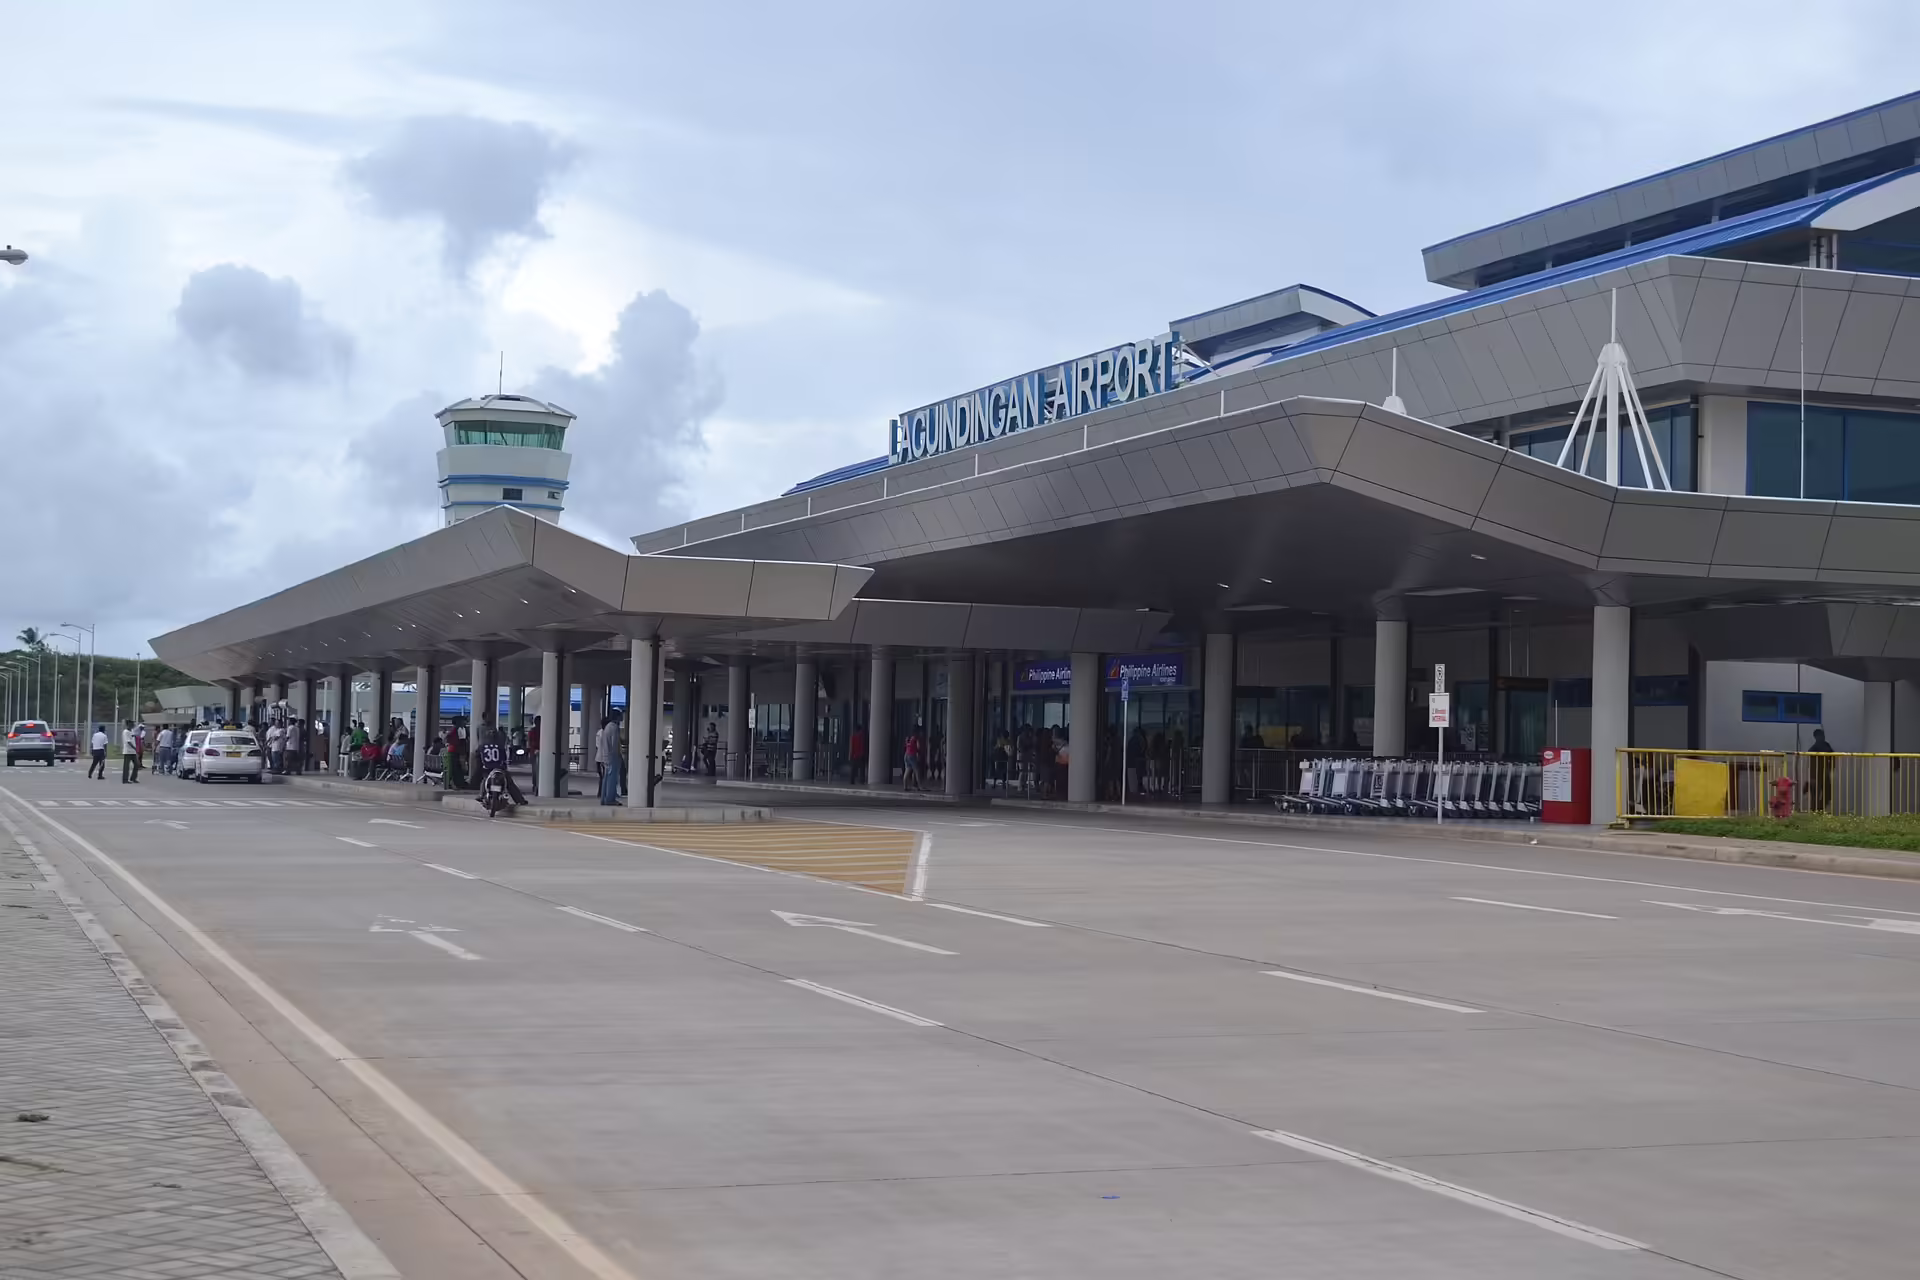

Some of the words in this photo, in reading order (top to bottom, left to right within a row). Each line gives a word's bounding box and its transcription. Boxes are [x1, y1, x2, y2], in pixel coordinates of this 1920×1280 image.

[888, 373, 1042, 465] LAGUINDINGAN
[1052, 332, 1178, 420] AIRPORT
[1028, 668, 1055, 684] Philippine
[1055, 667, 1071, 680] Airlin
[1120, 664, 1151, 681] Philippine
[1152, 663, 1177, 677] Airlines
[484, 748, 499, 762] 30
